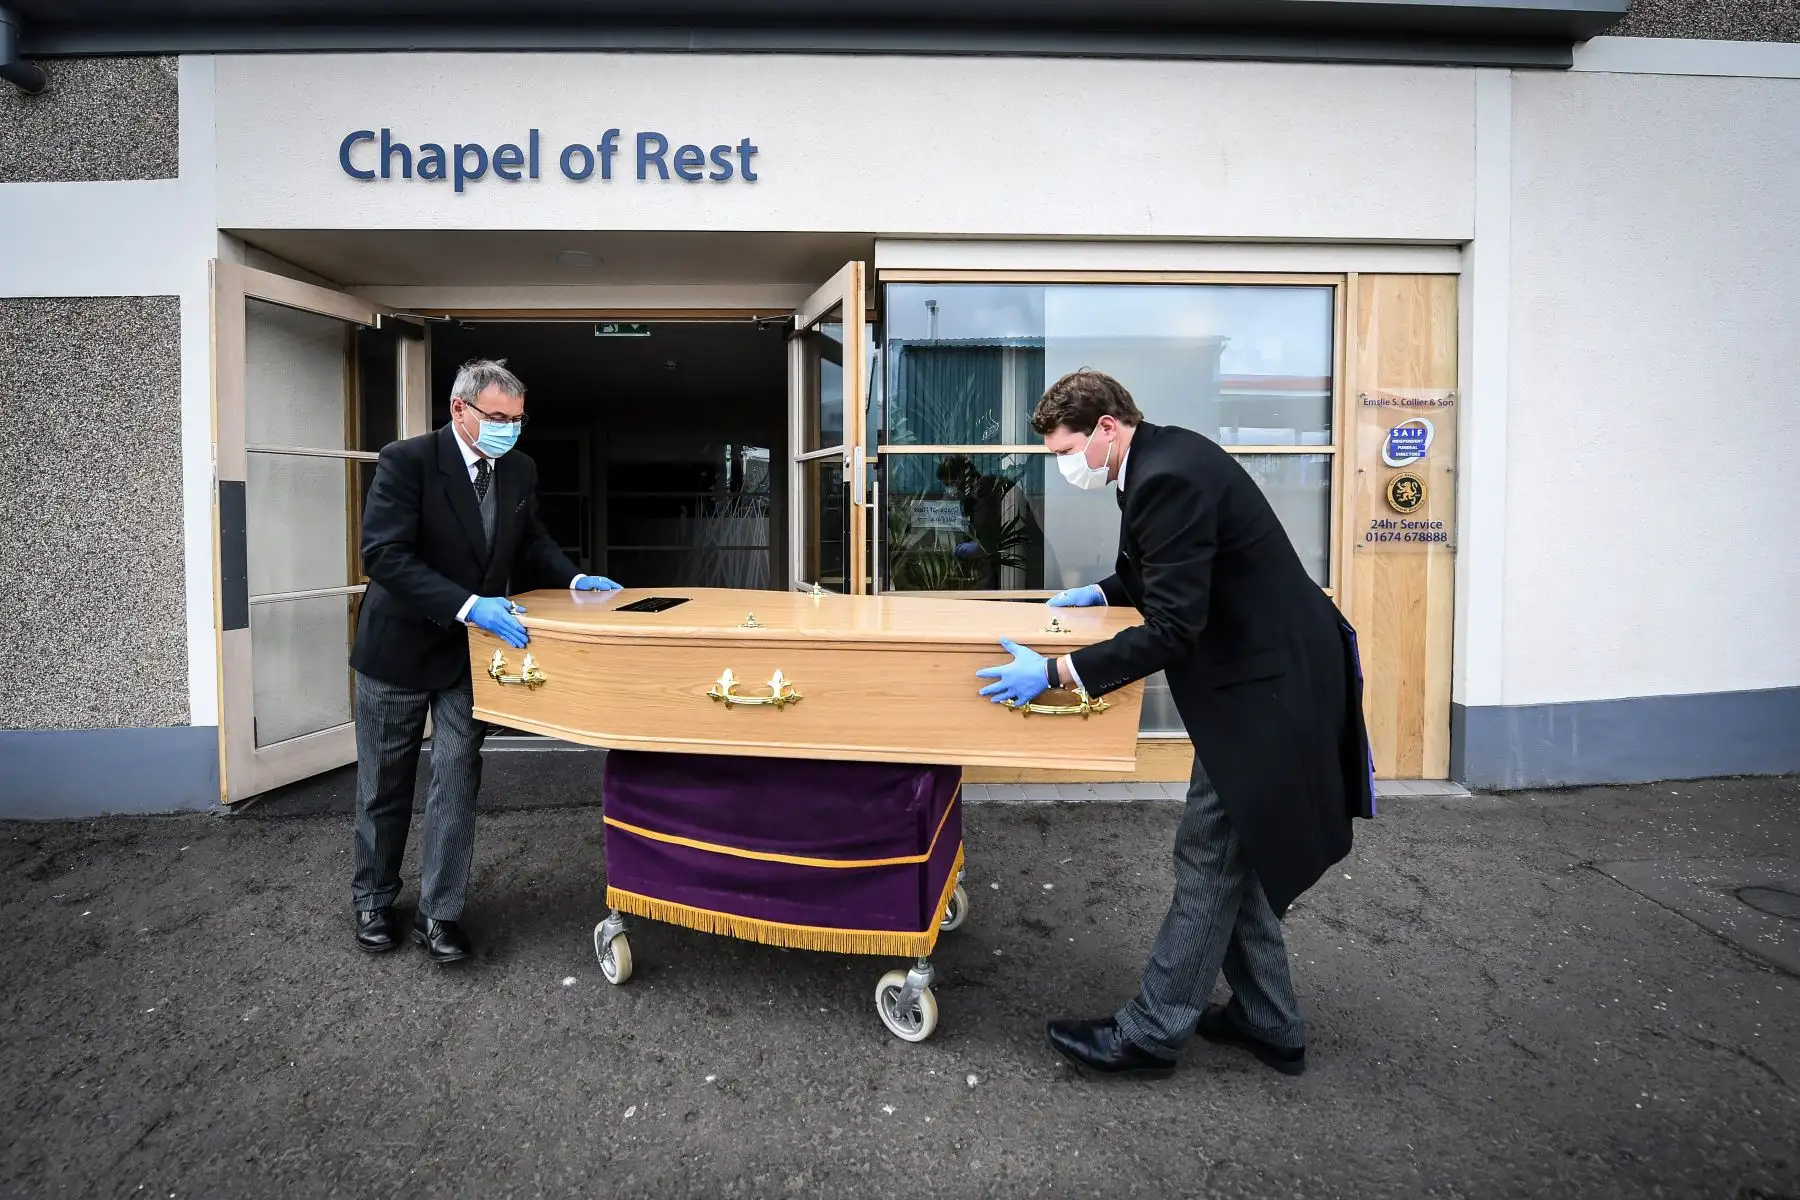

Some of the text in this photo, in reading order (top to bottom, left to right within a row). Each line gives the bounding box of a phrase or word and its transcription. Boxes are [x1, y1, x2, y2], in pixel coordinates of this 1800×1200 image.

[338, 128, 760, 193] Chapel of Rest
[1363, 398, 1454, 406] Emslie S. Collier & Son
[1393, 429, 1423, 437] SAIF
[1371, 519, 1443, 530] 24hr Service
[1366, 532, 1448, 542] 01674 678888
